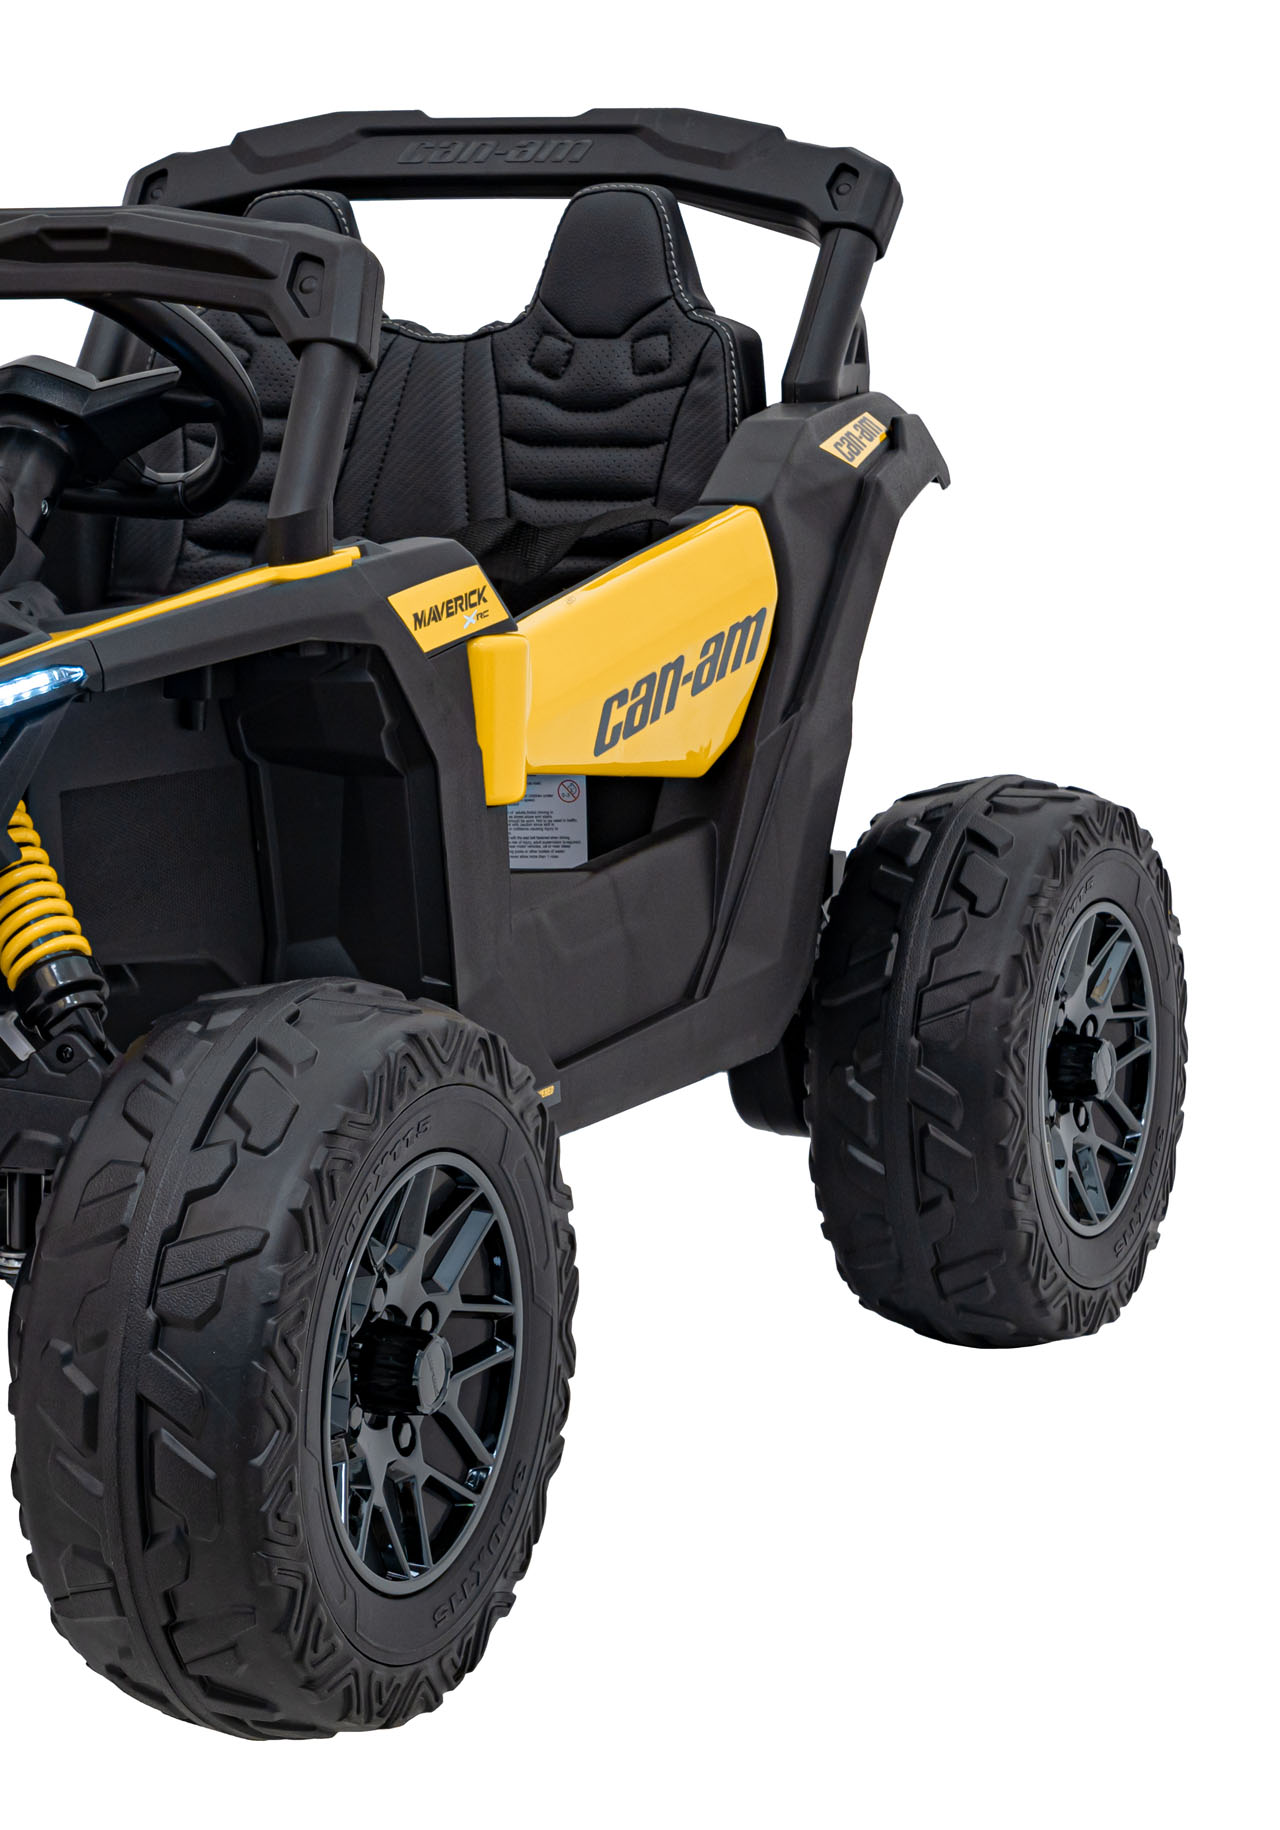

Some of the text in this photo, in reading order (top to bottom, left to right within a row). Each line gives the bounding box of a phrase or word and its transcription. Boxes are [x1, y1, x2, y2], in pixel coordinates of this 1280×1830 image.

[832, 416, 884, 463] can-am
[412, 585, 489, 632] MAVERICK
[593, 606, 768, 758] can-am
